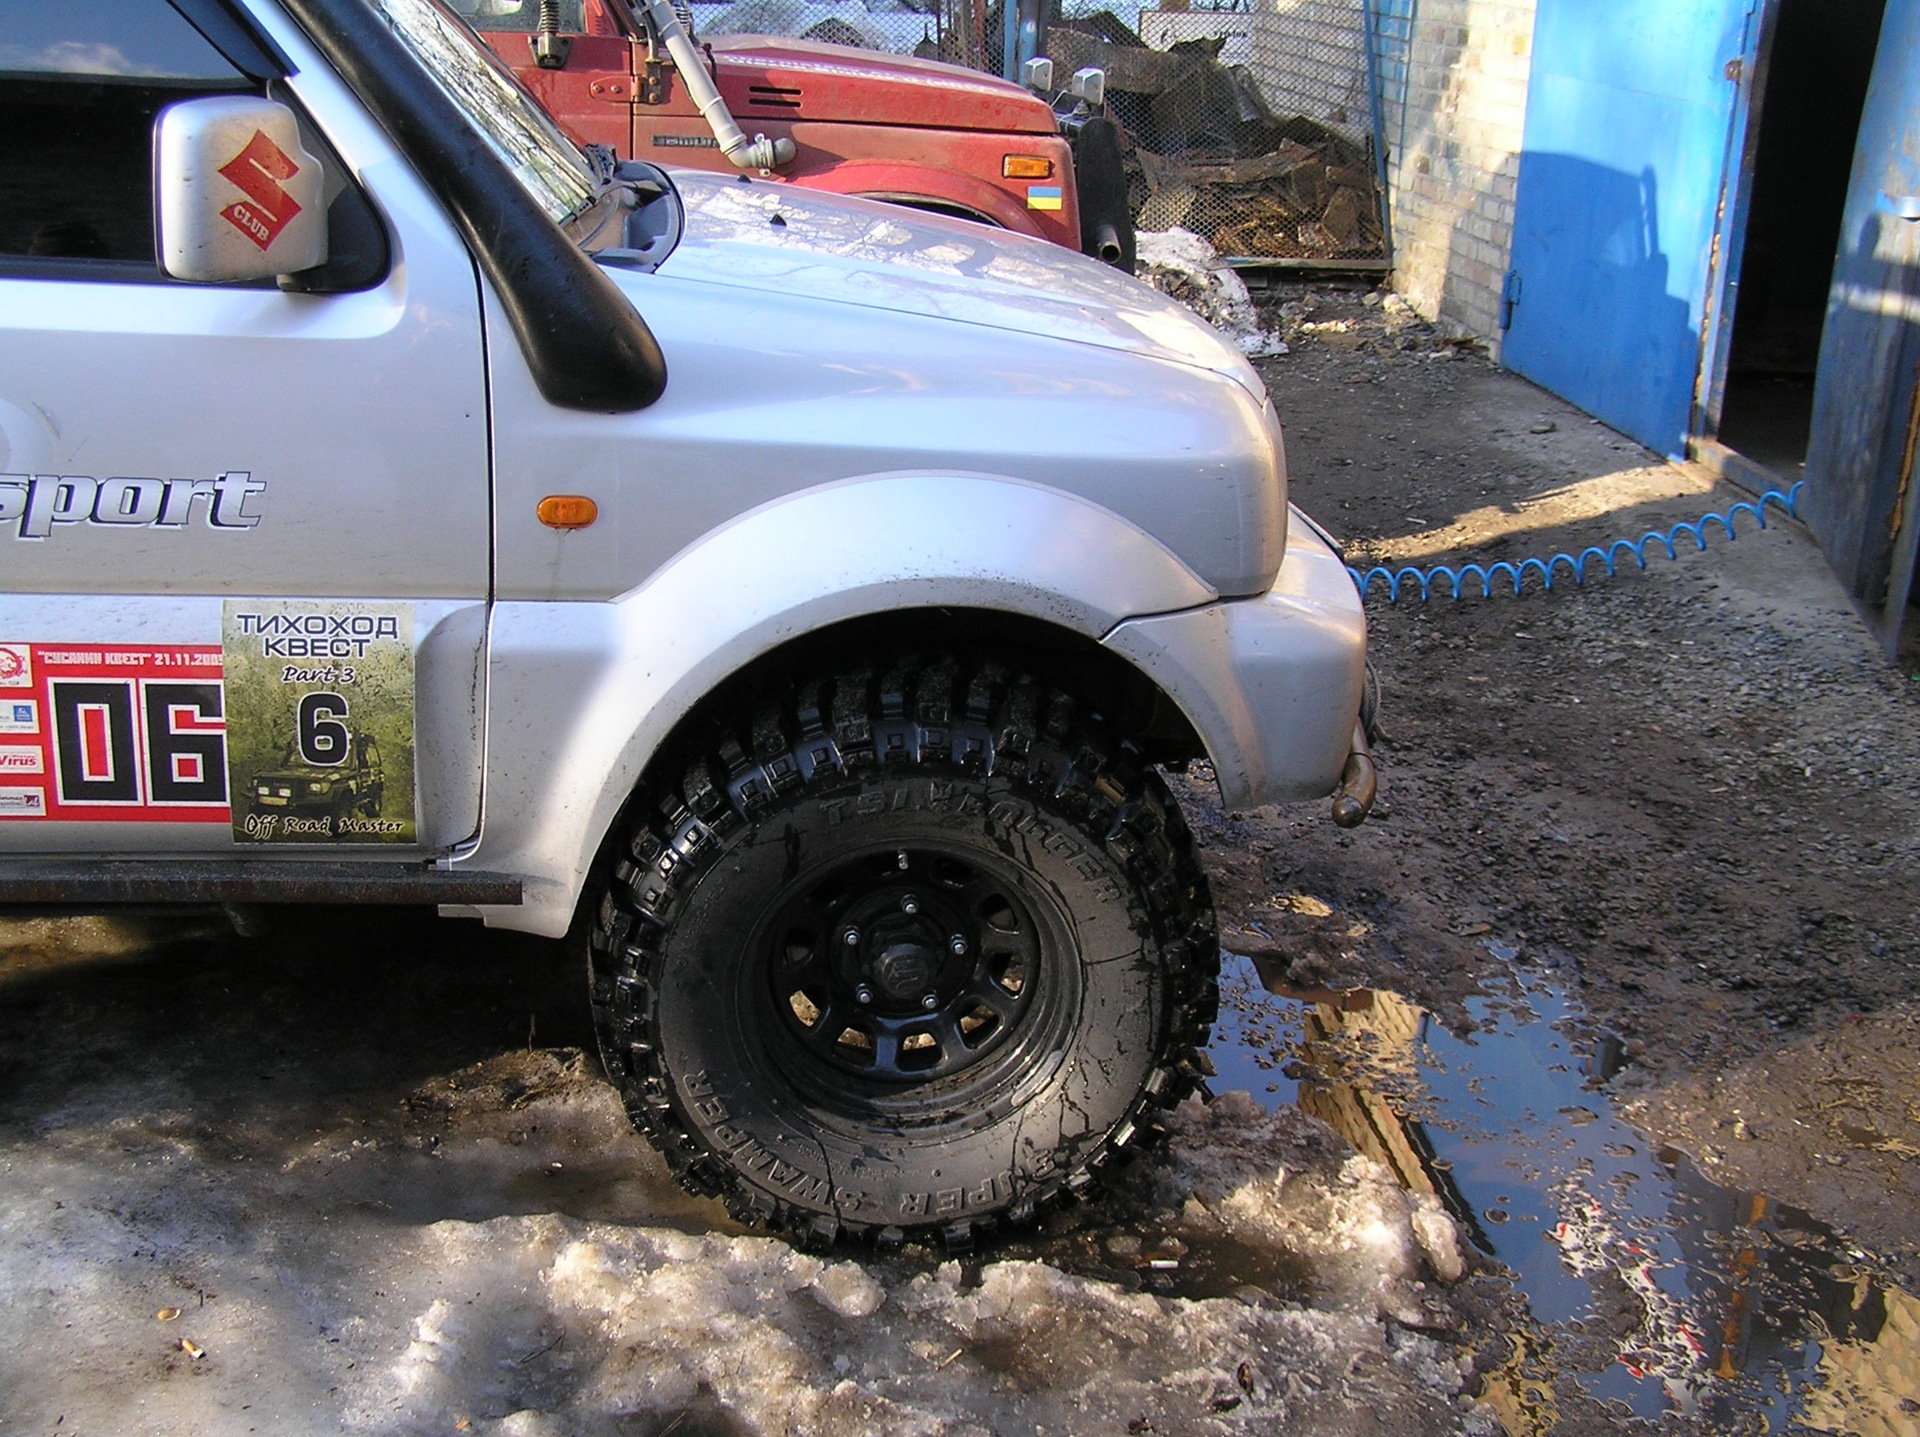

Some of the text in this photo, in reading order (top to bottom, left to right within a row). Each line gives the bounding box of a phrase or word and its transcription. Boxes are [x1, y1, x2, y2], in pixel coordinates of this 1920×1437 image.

[233, 204, 270, 242] CLUB
[236, 614, 399, 639] ТИХОХОД
[263, 637, 372, 658] КВЕСТ
[282, 665, 355, 684] Part 3
[48, 678, 231, 807] 06
[297, 691, 350, 767] 6
[245, 814, 404, 840] Off Road Master
[682, 1069, 1056, 1216] SUPER SWAMPER
